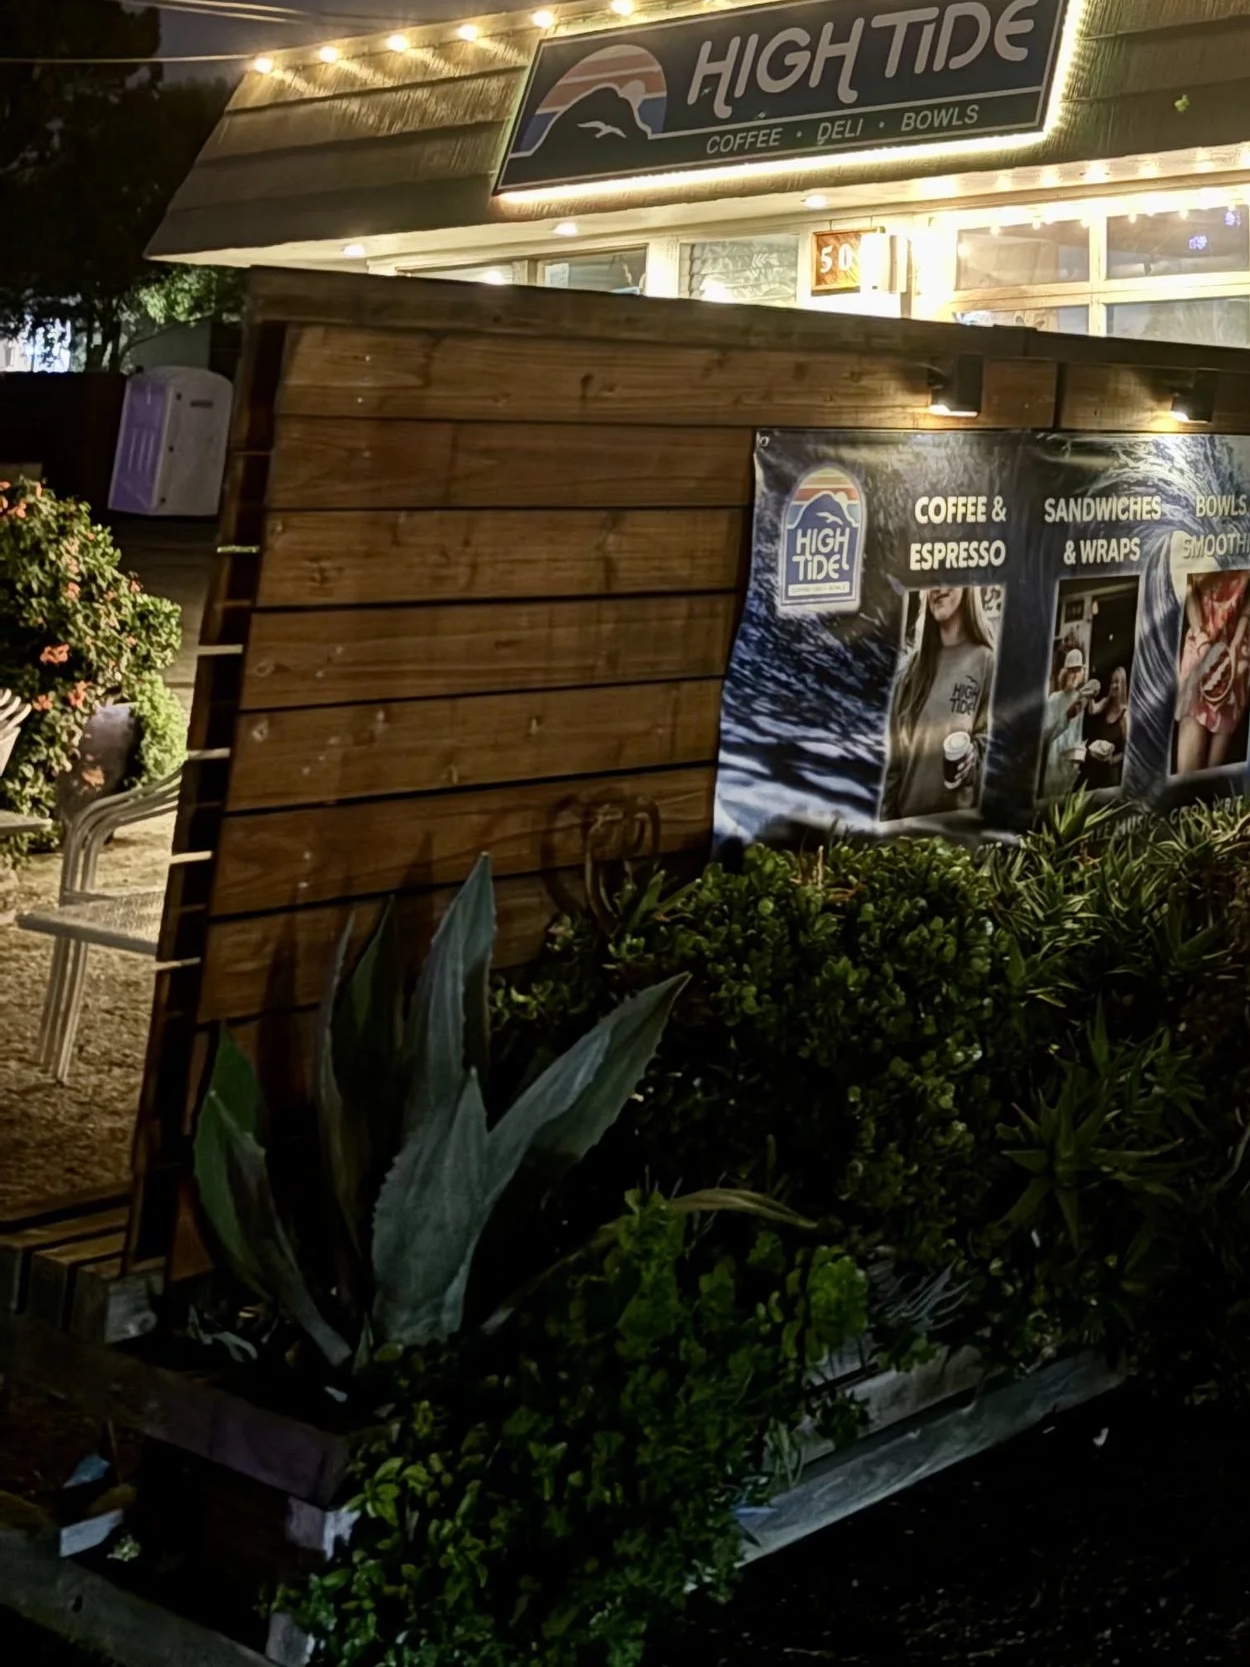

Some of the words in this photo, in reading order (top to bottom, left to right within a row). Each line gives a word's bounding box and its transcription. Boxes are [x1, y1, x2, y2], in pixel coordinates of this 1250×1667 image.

[687, 17, 865, 119] HIGH
[706, 127, 784, 155] COFFEE
[817, 118, 864, 142] DELI
[901, 104, 979, 132] BOWLS
[914, 496, 988, 525] COFFEE
[991, 495, 1007, 523] &
[1044, 495, 1162, 523] SANDWICHES
[1195, 494, 1248, 518] BOWLS
[796, 527, 850, 571] HIGH
[909, 540, 1006, 571] ESPRESSO
[1063, 540, 1077, 565] &
[1080, 537, 1141, 564] WRAPS
[792, 554, 841, 582] TIDE
